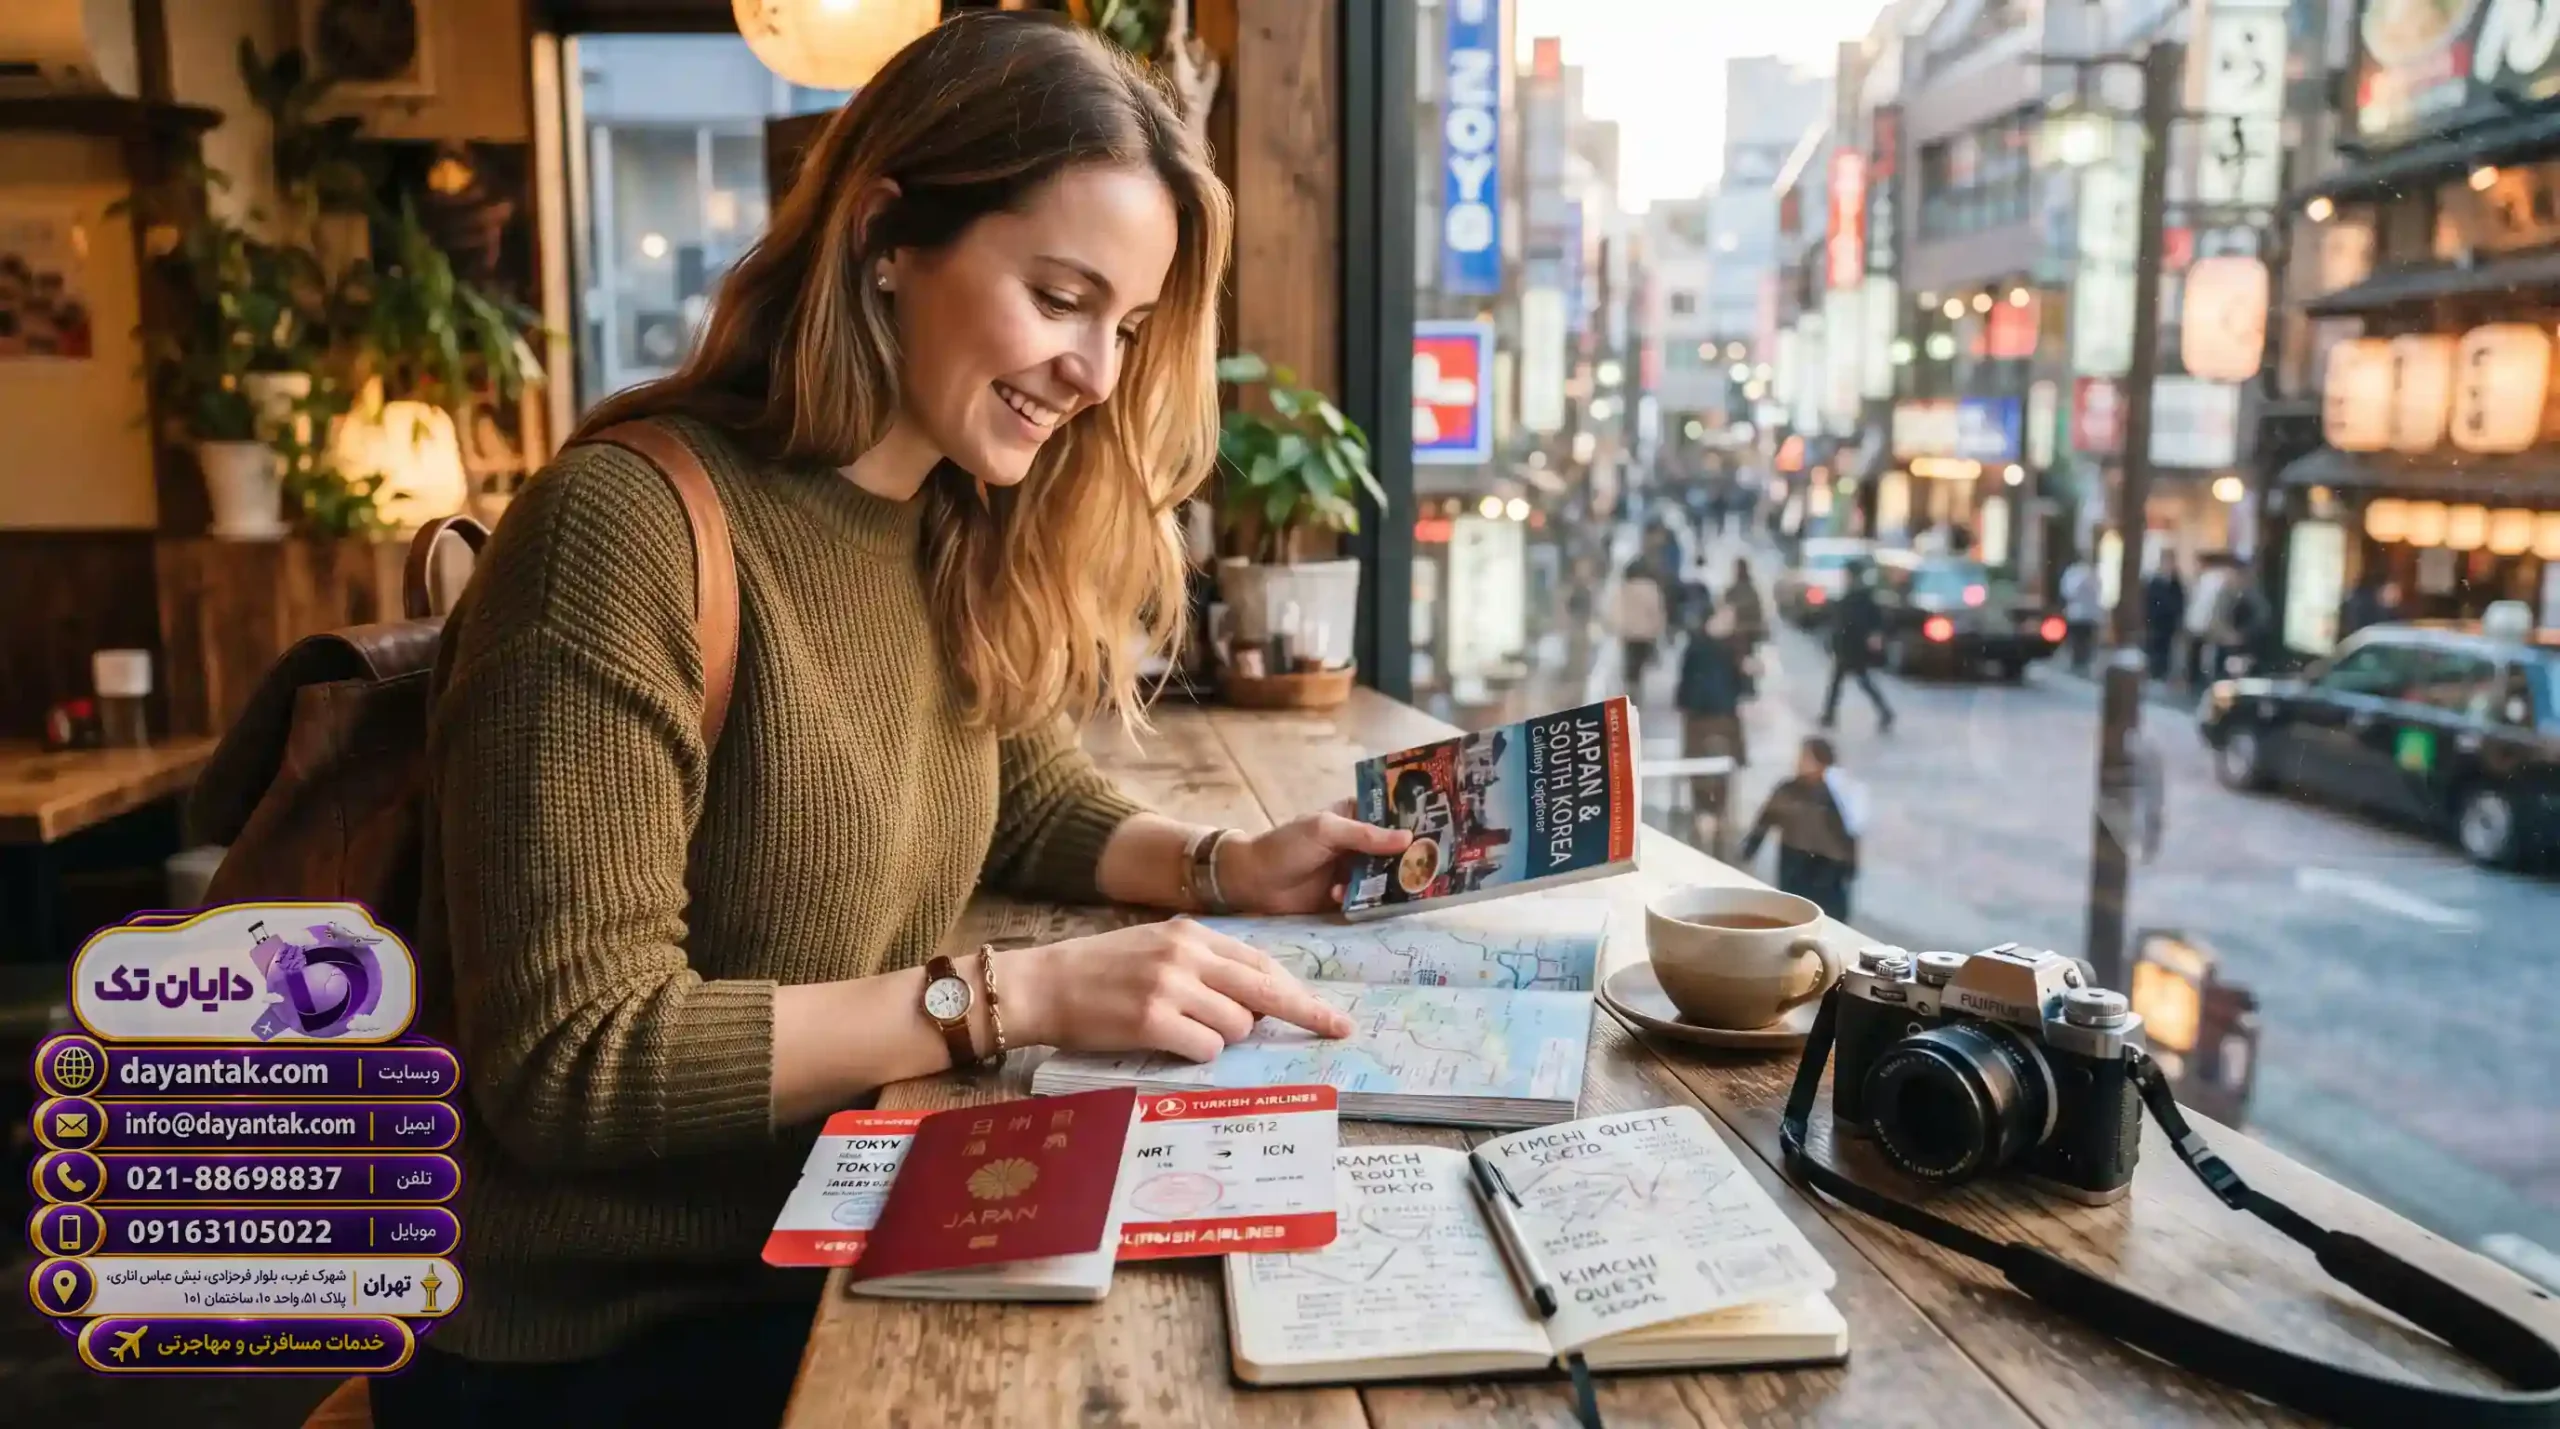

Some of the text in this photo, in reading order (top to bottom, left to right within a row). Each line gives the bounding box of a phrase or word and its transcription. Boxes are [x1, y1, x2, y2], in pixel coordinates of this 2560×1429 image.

[1575, 718, 1603, 823] JAPAN &
[1548, 721, 1573, 867] SOUTH KOREA
[1192, 1093, 1318, 1110] TURKISH AIRLINES
[1211, 1121, 1278, 1135] TK0612
[1137, 1144, 1176, 1158] NRT
[1263, 1143, 1295, 1156] ICN
[1500, 1130, 1586, 1158] KIMCHI
[836, 1162, 896, 1174] TOKYO
[1350, 1167, 1427, 1181] ROUTE
[1356, 1182, 1434, 1195] TOKYO
[943, 1204, 1038, 1228] JAPAN
[1559, 1254, 1658, 1286] KIMCHI
